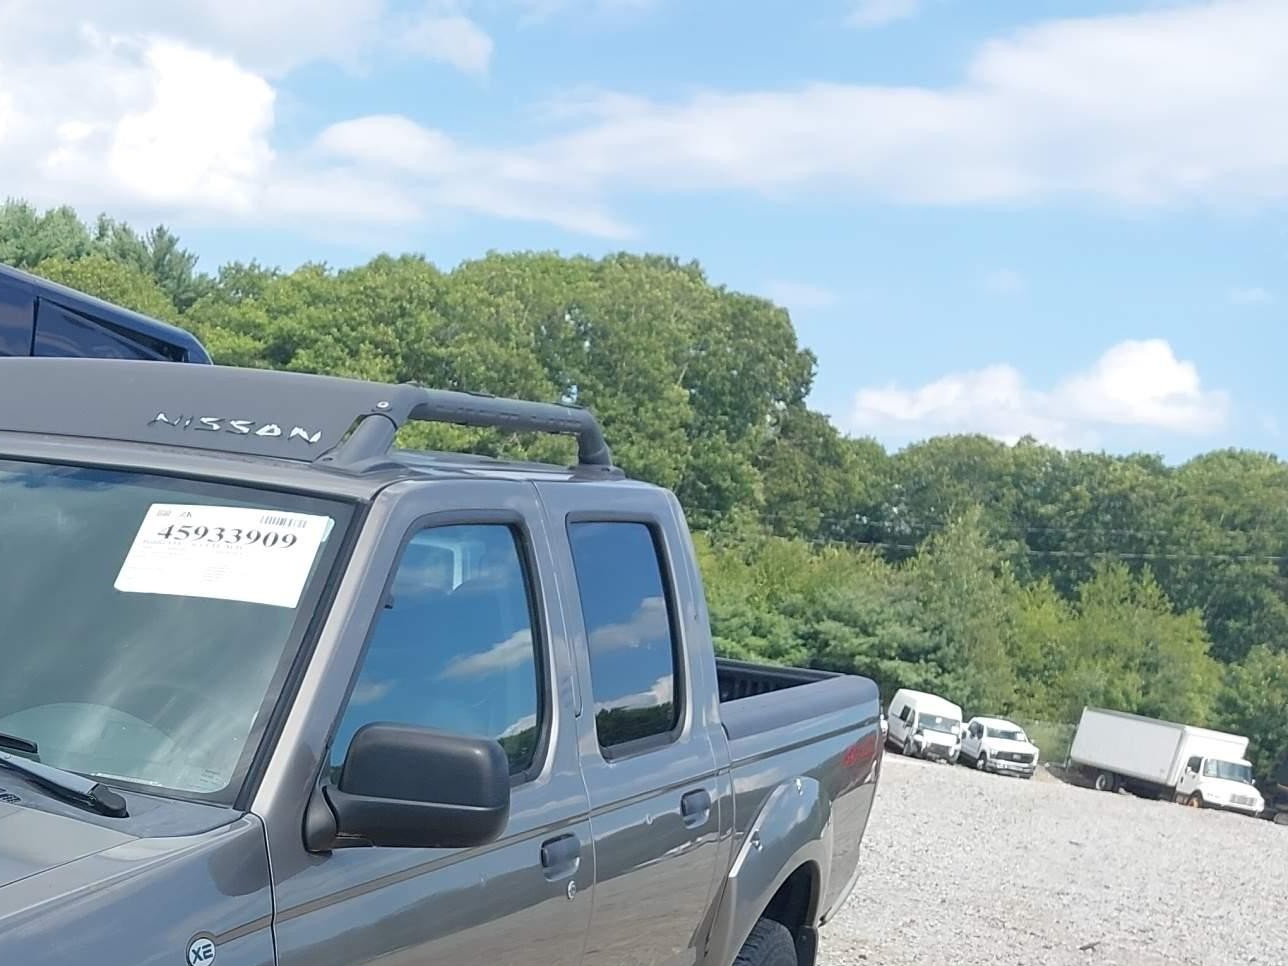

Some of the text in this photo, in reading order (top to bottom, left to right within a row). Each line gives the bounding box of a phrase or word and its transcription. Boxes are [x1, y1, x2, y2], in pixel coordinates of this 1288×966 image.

[148, 412, 321, 444] NISSAN
[157, 524, 298, 549] 45933909
[192, 943, 213, 965] XE
